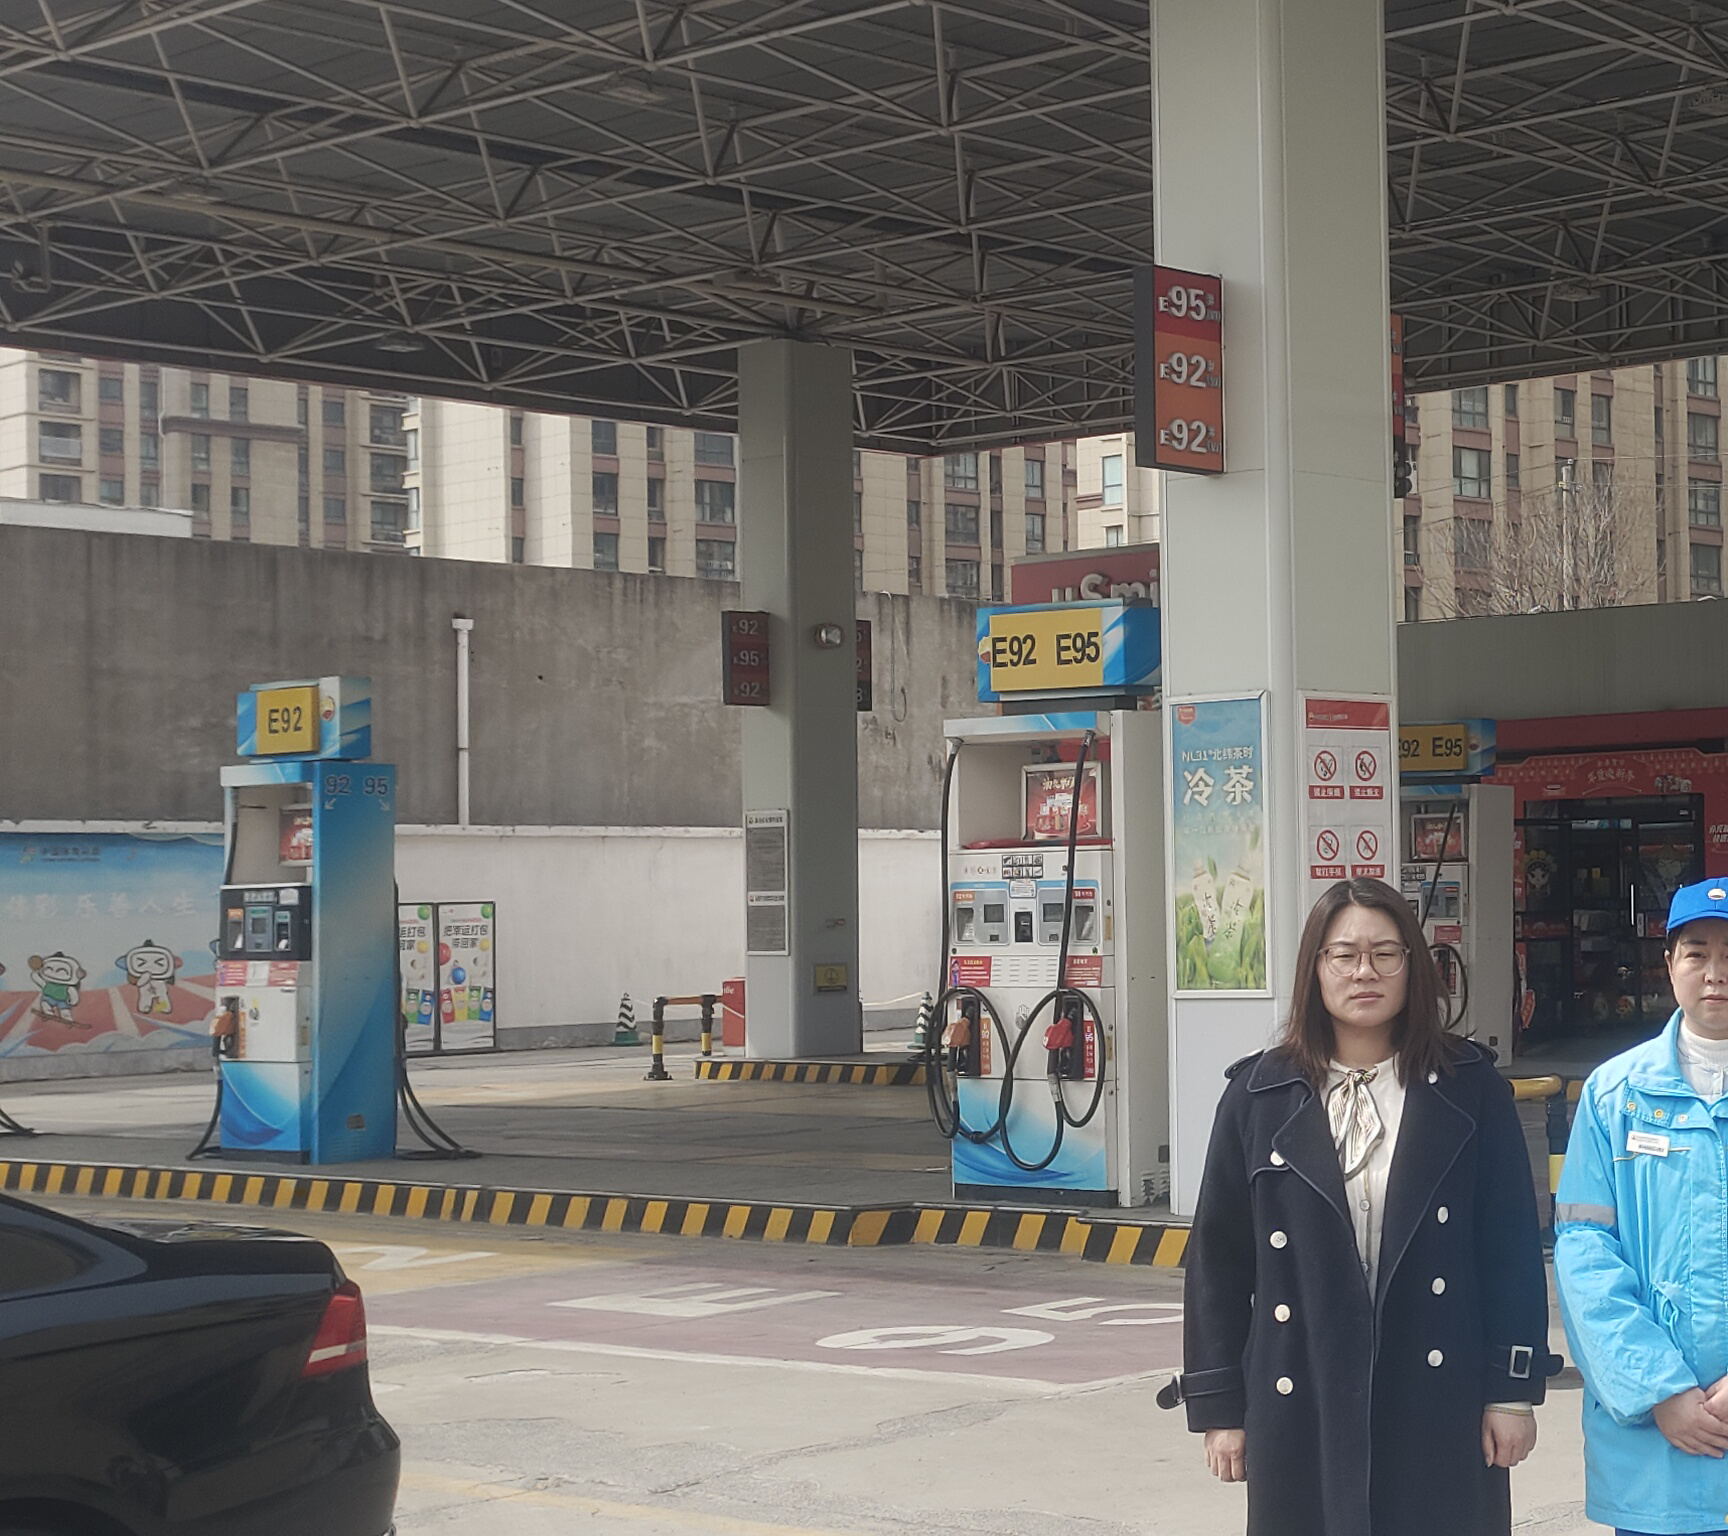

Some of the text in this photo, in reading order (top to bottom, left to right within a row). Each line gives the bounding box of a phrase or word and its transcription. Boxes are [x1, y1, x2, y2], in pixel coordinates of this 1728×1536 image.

[991, 632, 1100, 668] E92 E95
[268, 706, 303, 734] E92
[1432, 737, 1463, 757] E95
[325, 775, 388, 795] 92 95
[1183, 764, 1255, 806] 冷茶
